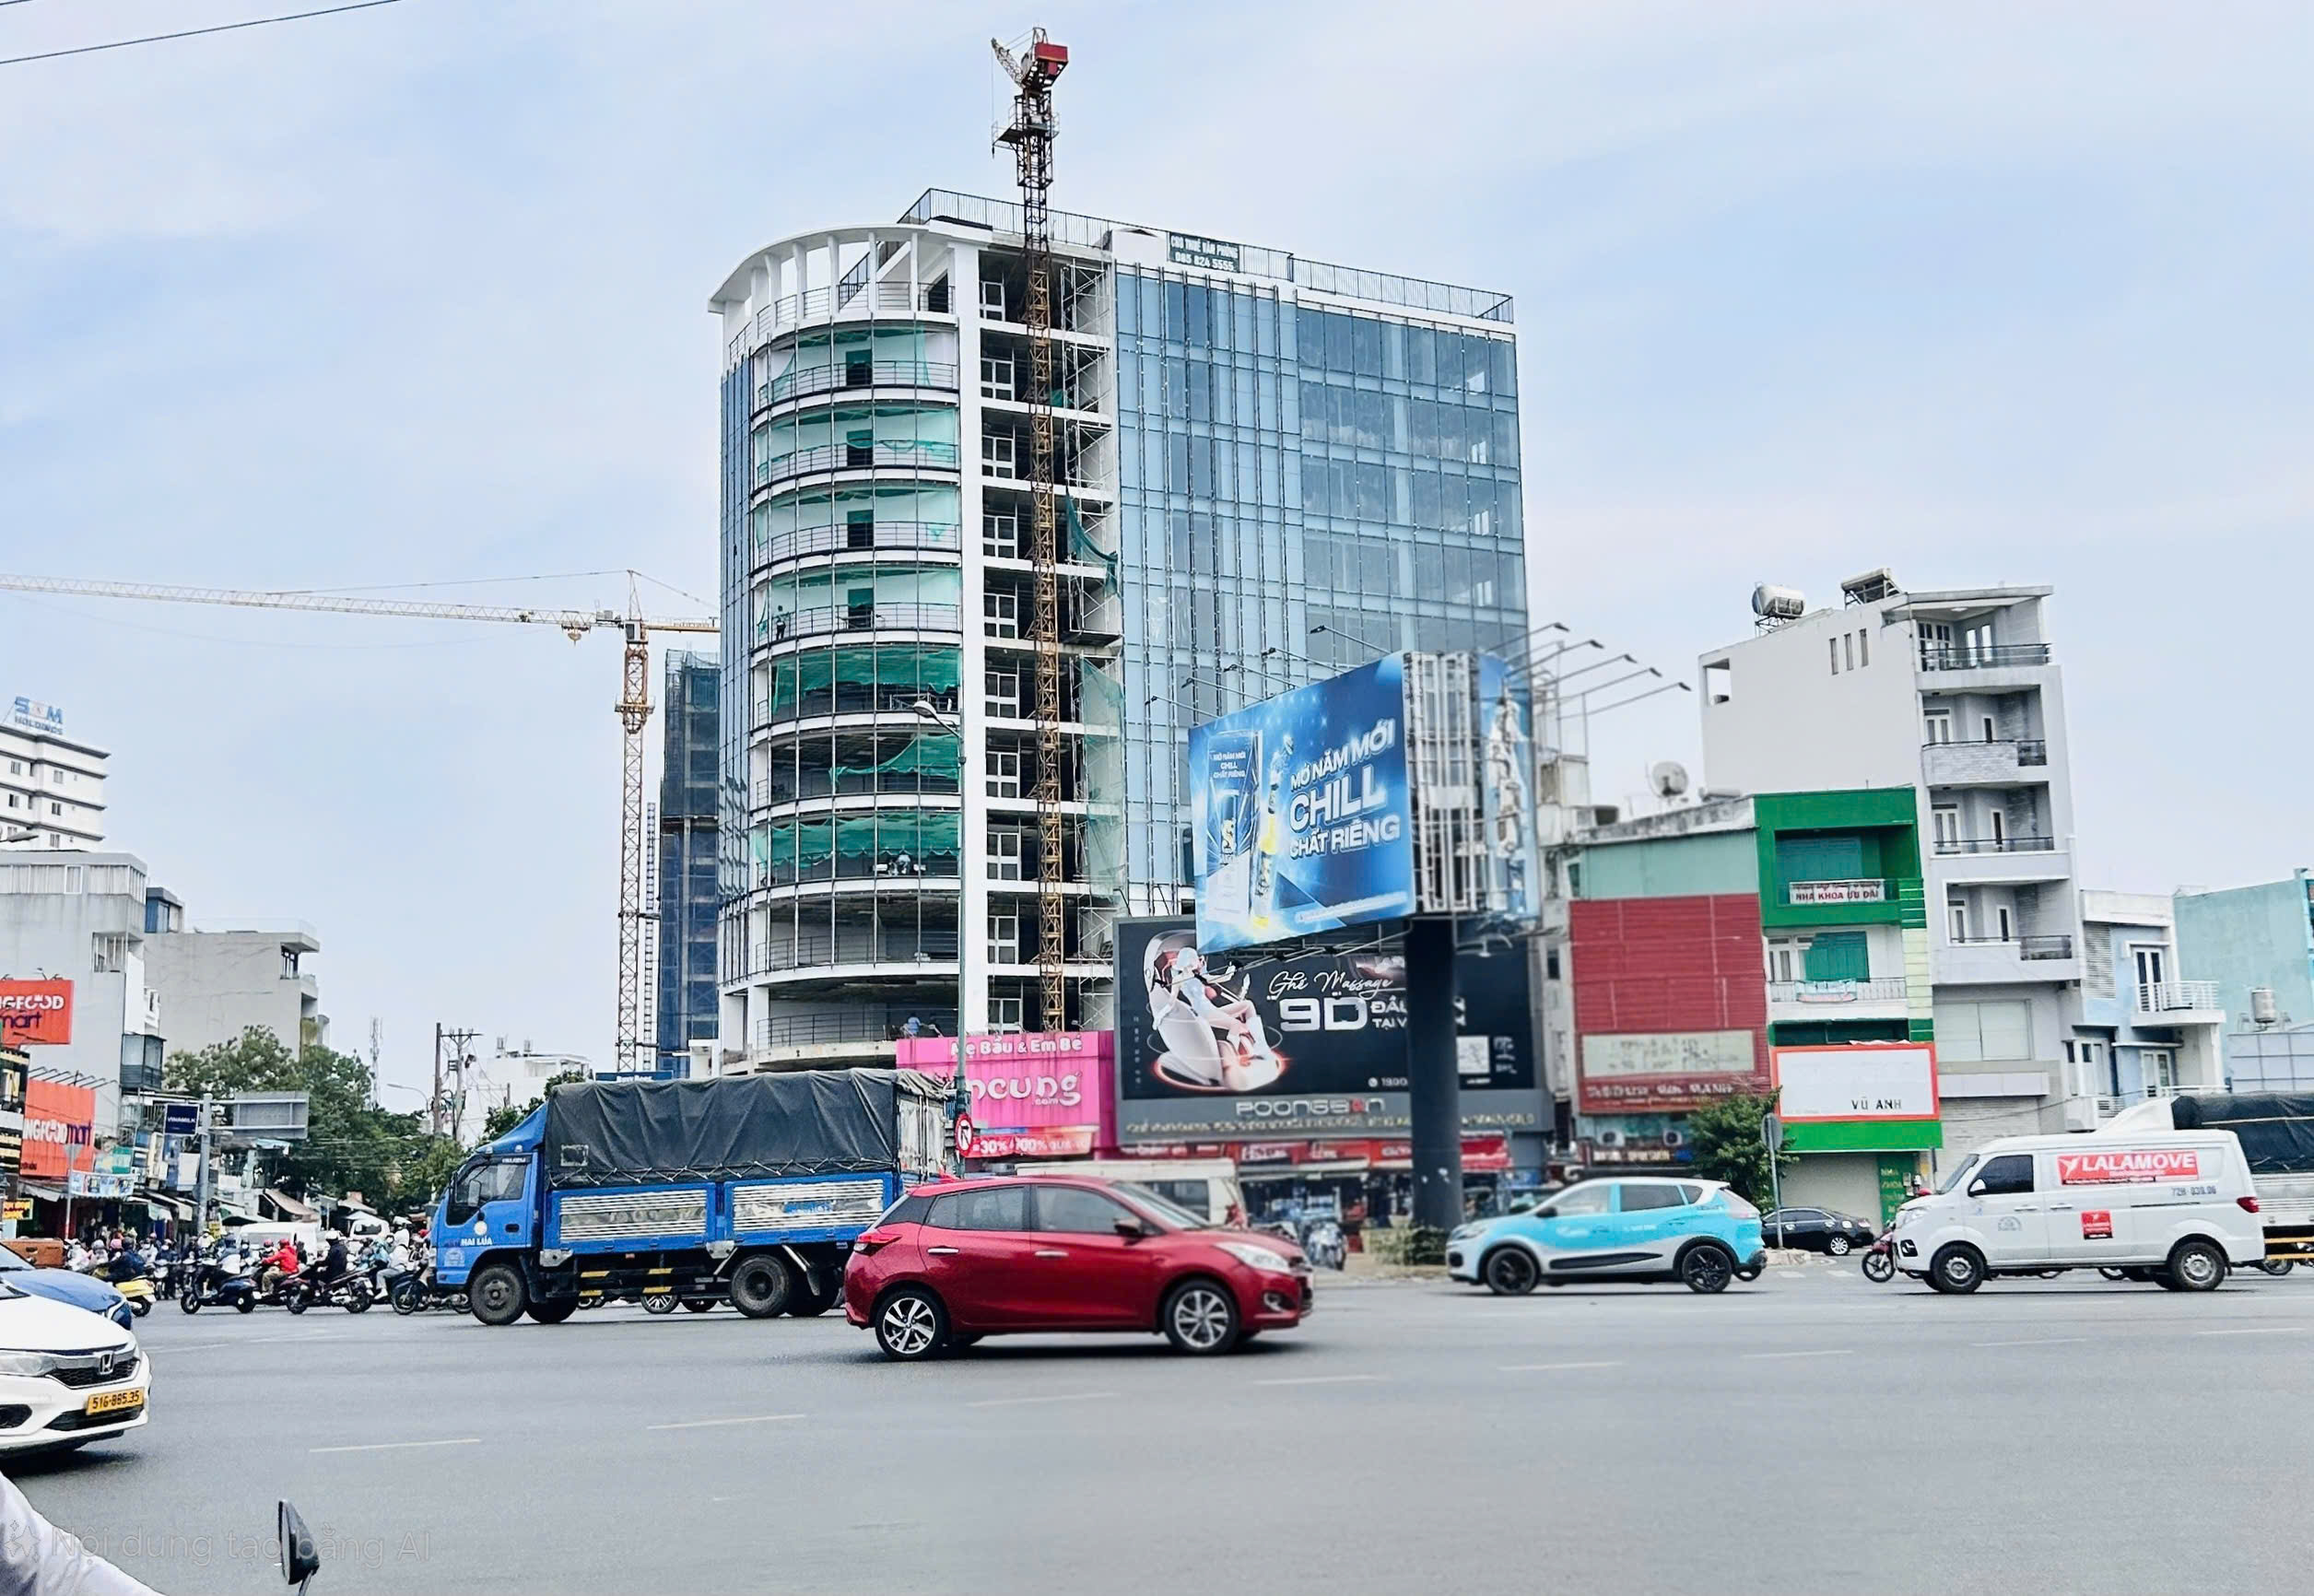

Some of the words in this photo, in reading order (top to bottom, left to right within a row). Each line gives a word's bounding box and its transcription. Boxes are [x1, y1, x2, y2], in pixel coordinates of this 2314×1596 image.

[1311, 745, 1349, 781] NĂM
[1351, 718, 1396, 764] MỚI
[1290, 765, 1387, 832] CHILL
[1290, 827, 1329, 860] CHẤT
[1331, 815, 1401, 852] RIÊNG
[1818, 891, 1843, 899] KHOA
[1314, 970, 1405, 1001] Massage
[0, 994, 65, 1010] GFOOD
[1279, 996, 1368, 1032] 9D
[1017, 1040, 1028, 1053] &
[1030, 1039, 1057, 1053] Em
[1060, 1034, 1083, 1052] Bé
[1876, 1099, 1901, 1110] ANH
[23, 1120, 68, 1144] INGFOOD
[2082, 1154, 2196, 1171] LALAMOVE
